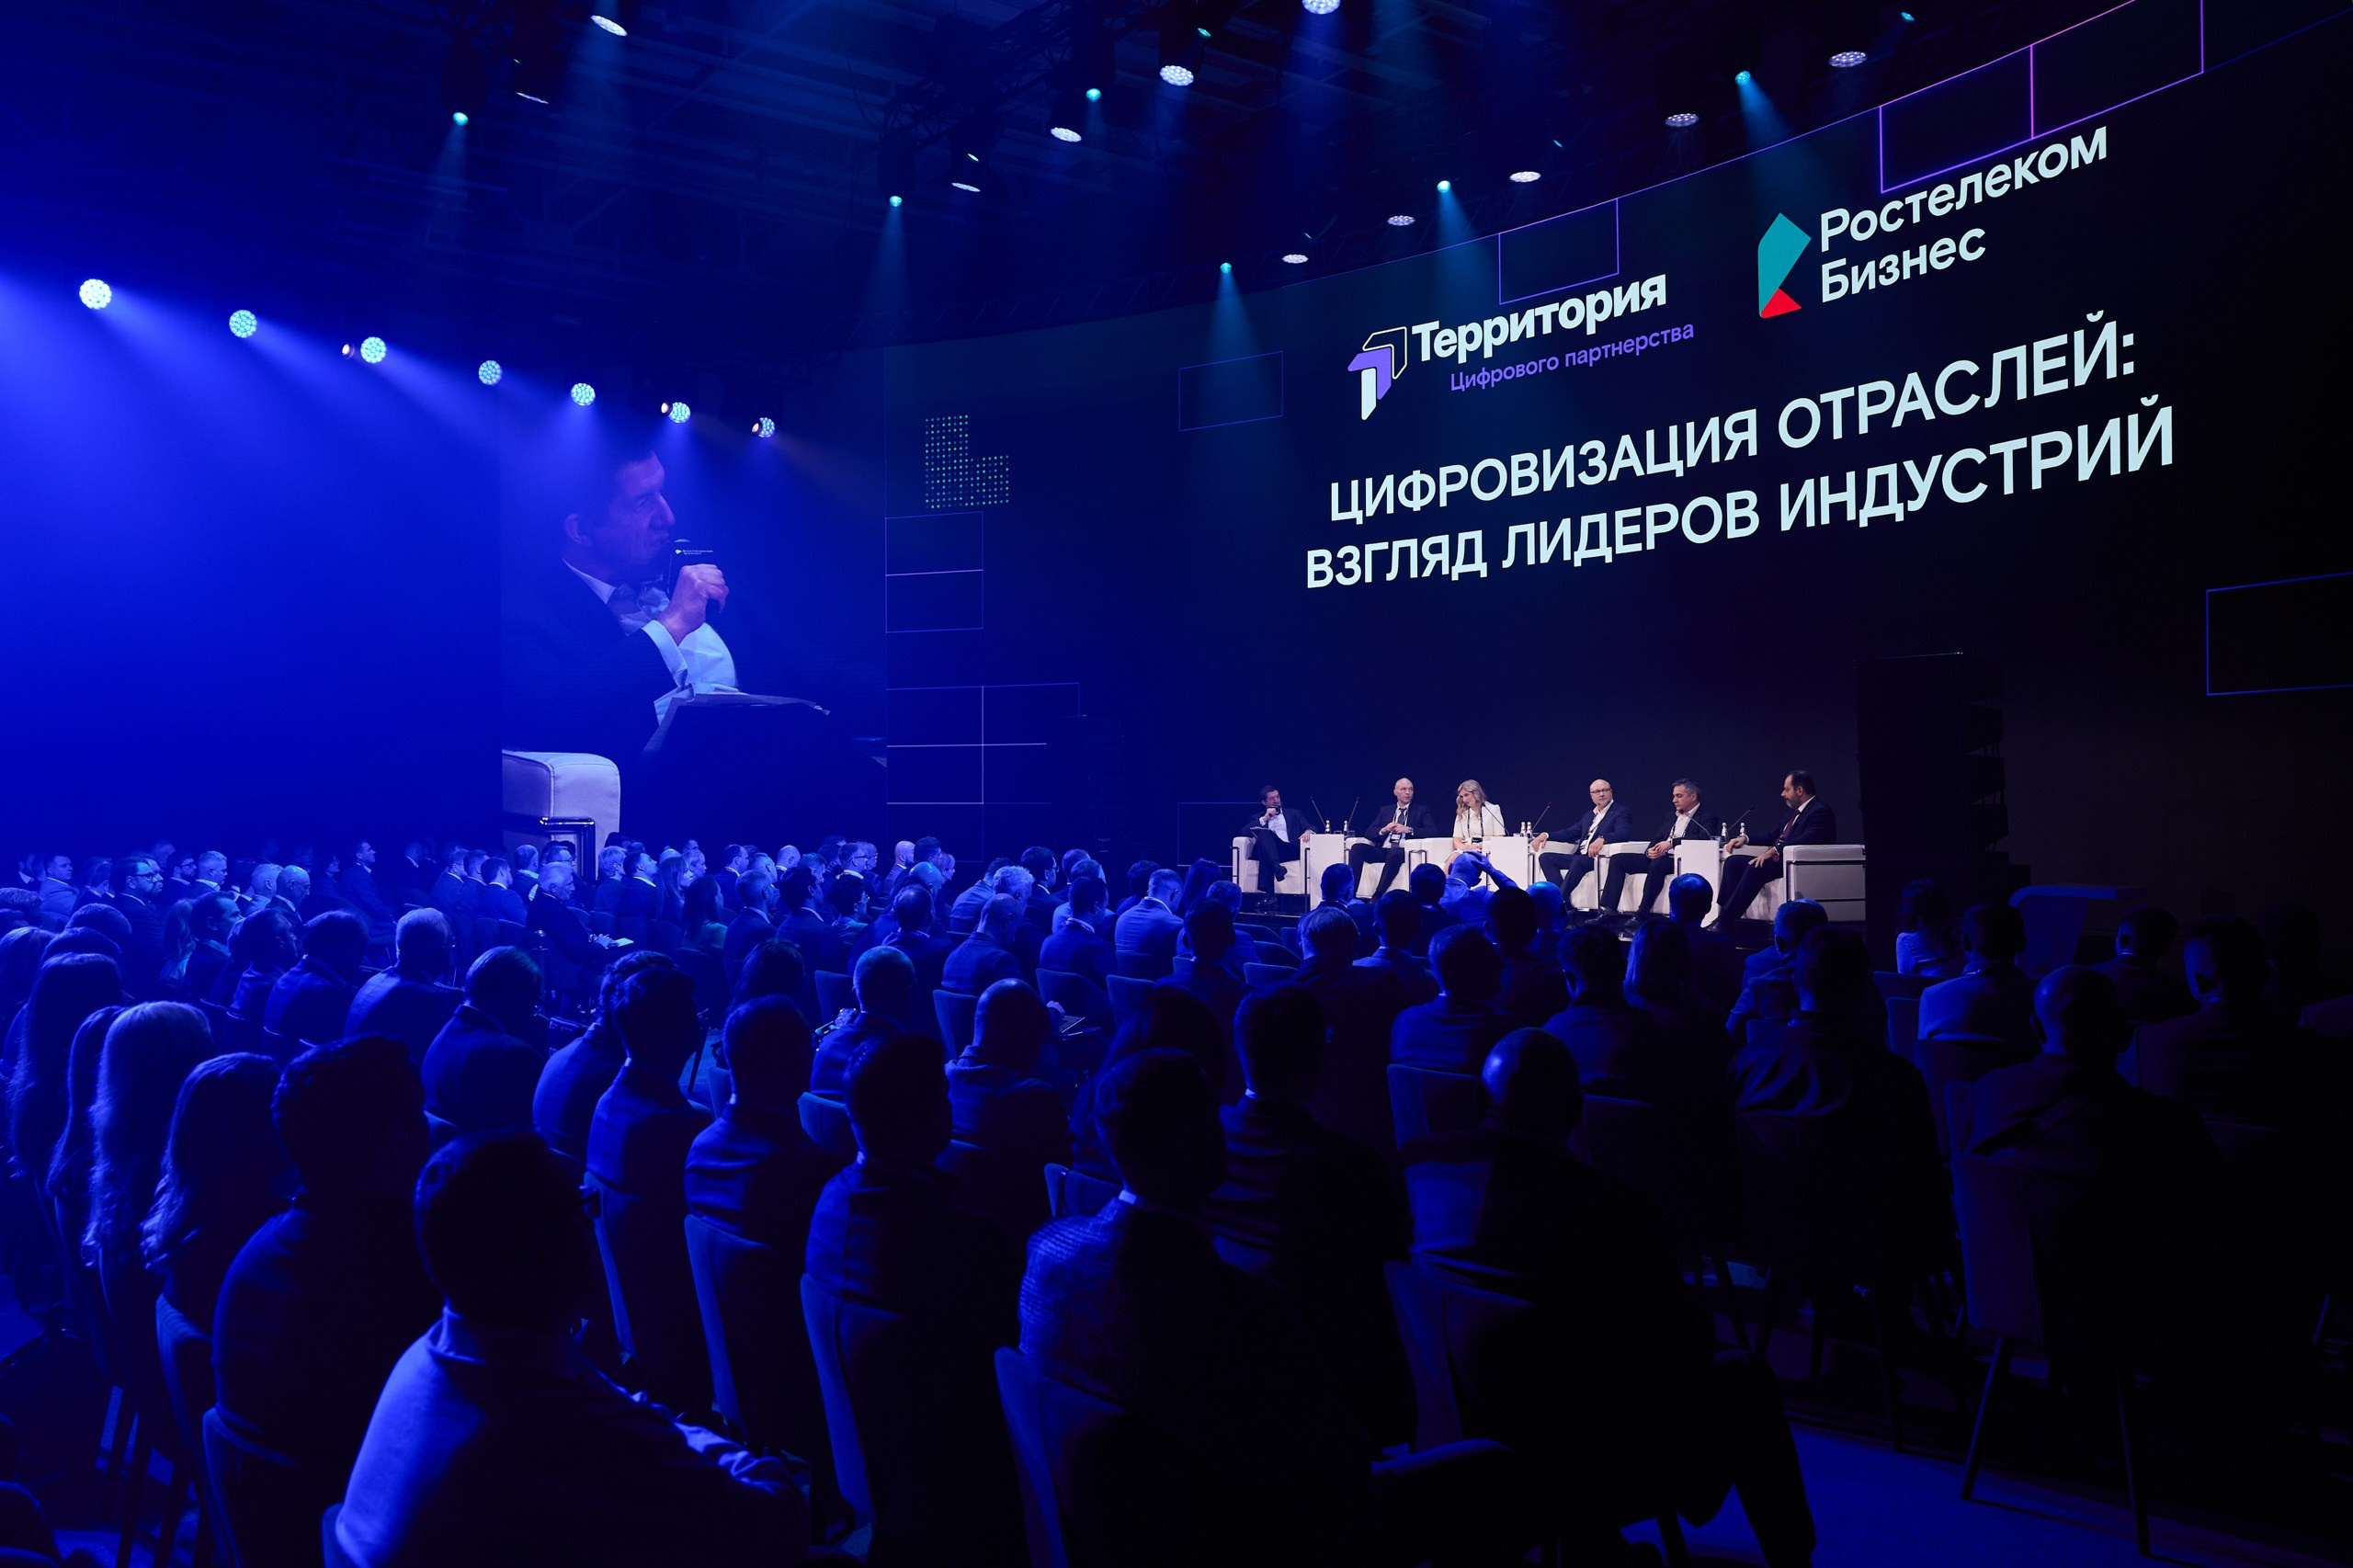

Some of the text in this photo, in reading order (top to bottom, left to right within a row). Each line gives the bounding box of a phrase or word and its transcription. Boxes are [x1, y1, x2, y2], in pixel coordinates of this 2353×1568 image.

[1821, 126, 2107, 252] Ростелеком
[1412, 274, 1665, 364] Территория
[1822, 228, 1985, 302] Бизнес
[1451, 324, 1693, 392] Цифрового партнерства
[1332, 310, 2133, 525] ЦИФРОВИЗАЦИЯ ОТРАСЛЕЙ:
[1308, 394, 2172, 588] ВЗГЛЯД ЛИДЕРОВ ИНДУСТРИЙ
